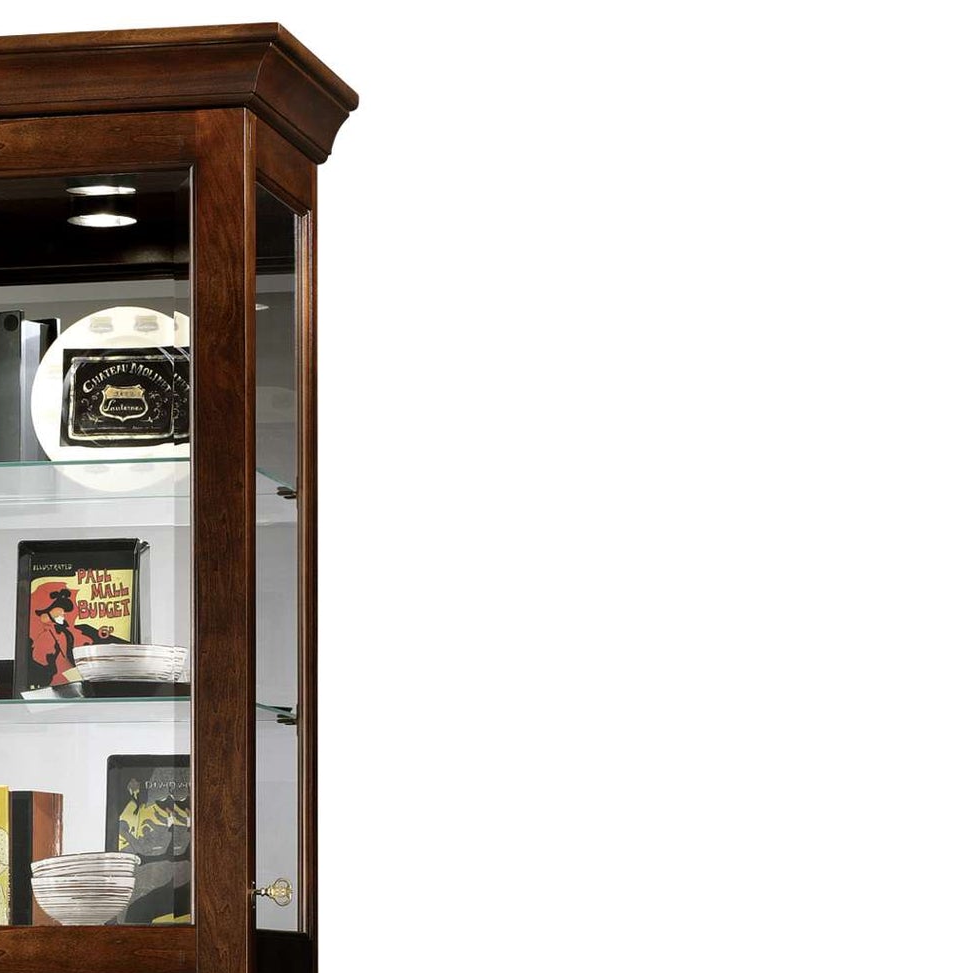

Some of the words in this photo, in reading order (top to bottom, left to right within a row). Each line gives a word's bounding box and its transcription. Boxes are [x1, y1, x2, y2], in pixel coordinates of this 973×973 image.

[33, 563, 73, 571] ILLUSTRATED
[77, 568, 111, 585] PALL
[90, 582, 129, 600] MALL
[77, 598, 131, 620] BUDGET
